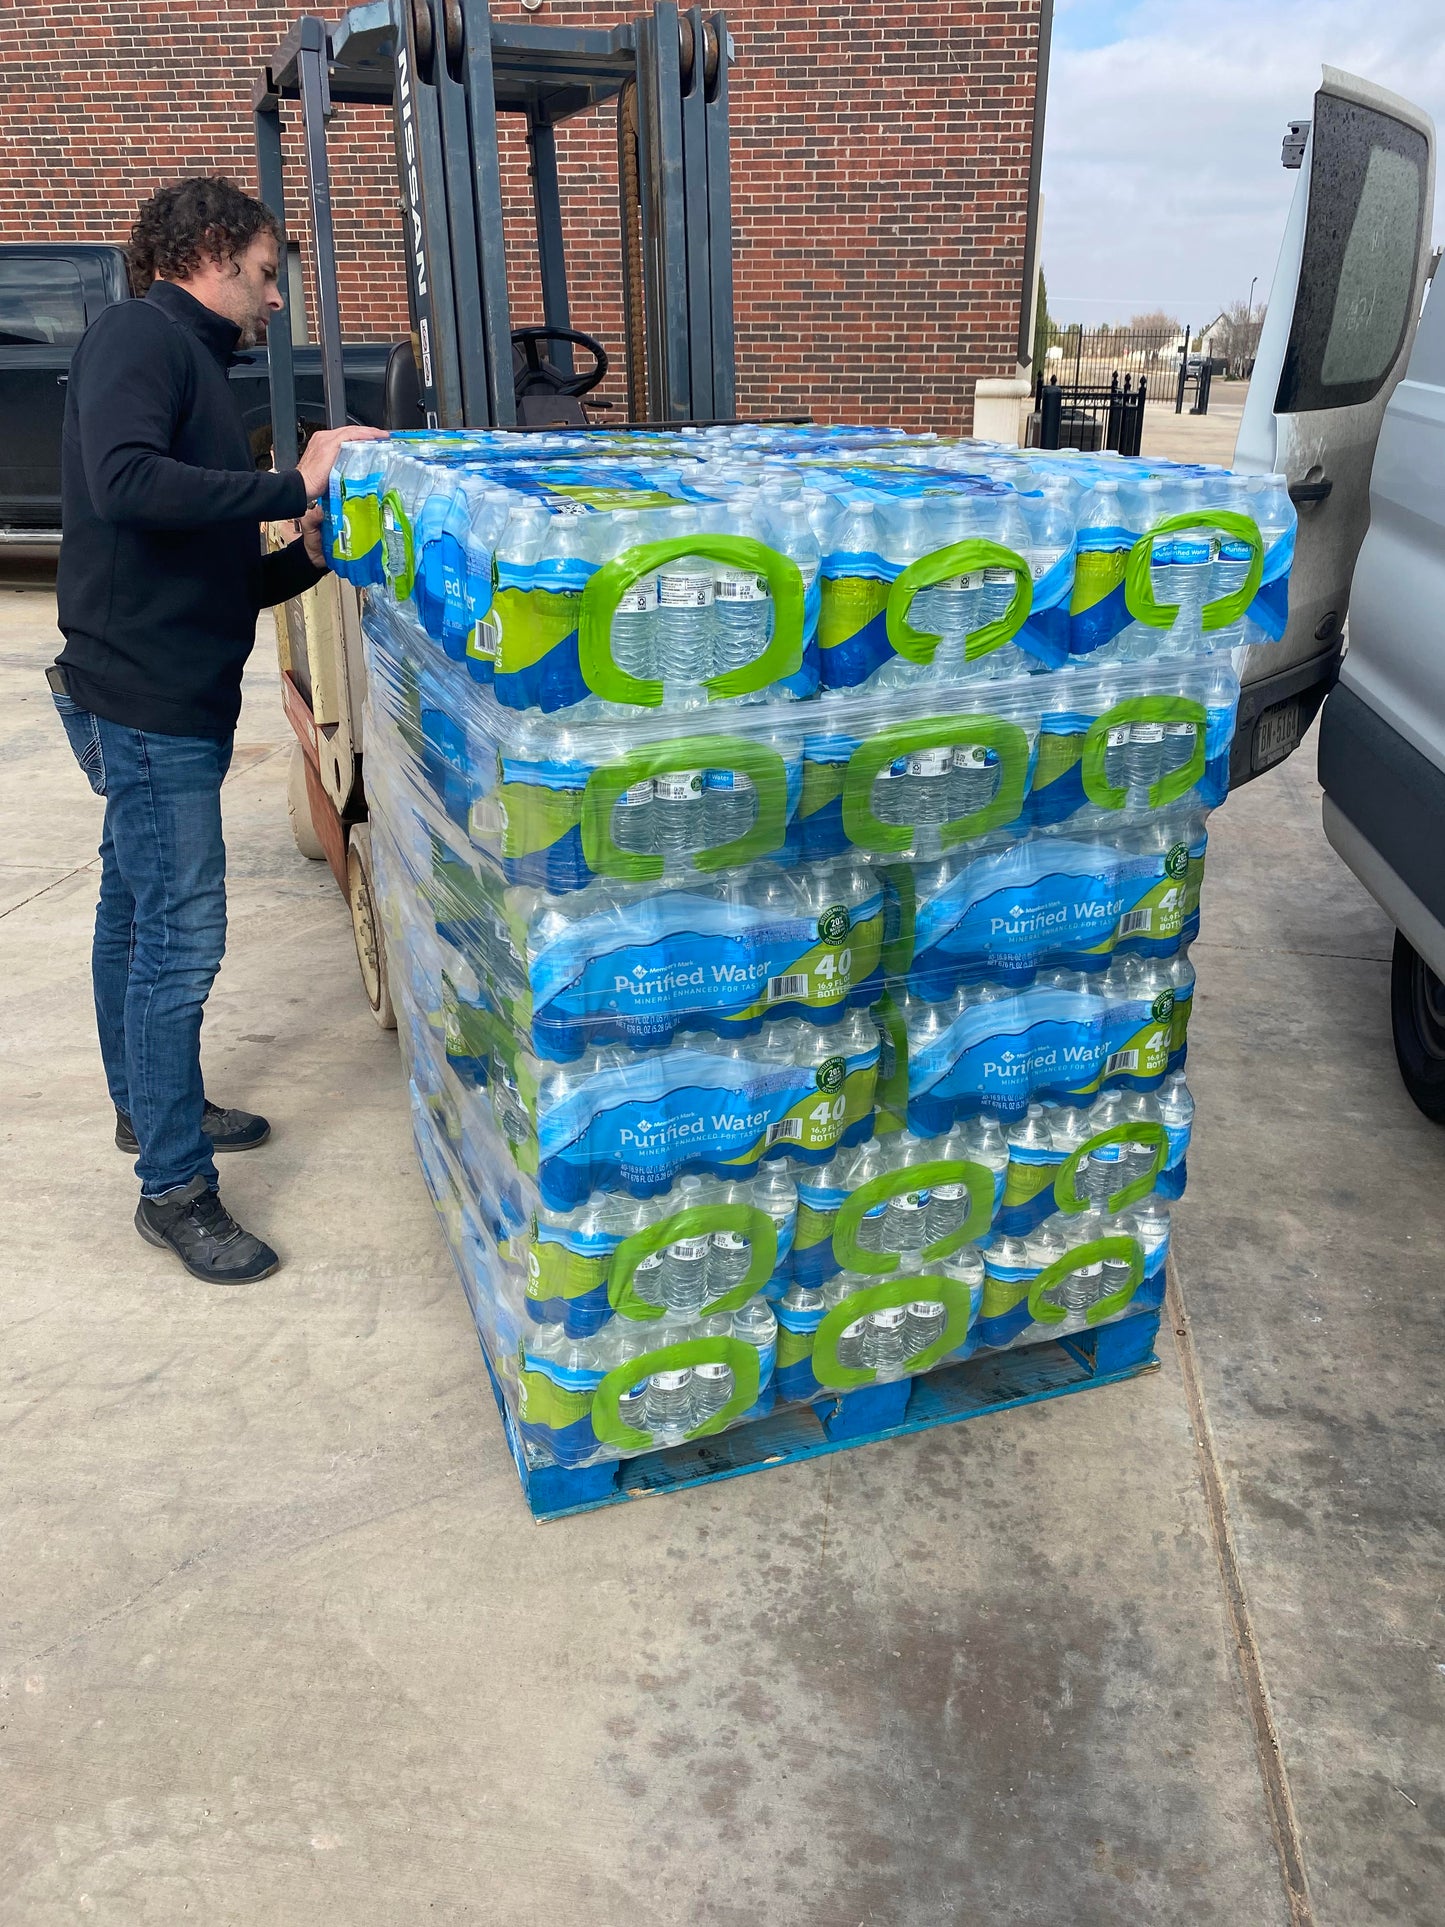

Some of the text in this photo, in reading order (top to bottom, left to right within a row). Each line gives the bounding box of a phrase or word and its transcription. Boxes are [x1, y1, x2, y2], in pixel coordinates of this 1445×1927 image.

[398, 47, 428, 297] NISSAN
[990, 898, 1125, 935] Purified Water
[614, 960, 772, 996] Purified Water
[814, 947, 852, 980] 40
[673, 985, 719, 998] ENHANCED
[721, 984, 739, 993] FOR
[817, 982, 834, 990] 16.9
[983, 1050, 1056, 1078] Purified
[1062, 1041, 1112, 1062] Water
[1070, 1061, 1086, 1070] FOR
[809, 1094, 846, 1125] 40
[619, 1108, 772, 1148] Purified Water
[811, 1126, 827, 1134] 16.9
[620, 1162, 639, 1174] 40-16.9
[645, 1165, 654, 1175] OZ
[620, 1170, 630, 1180] NET
[646, 1173, 655, 1183] OZ
